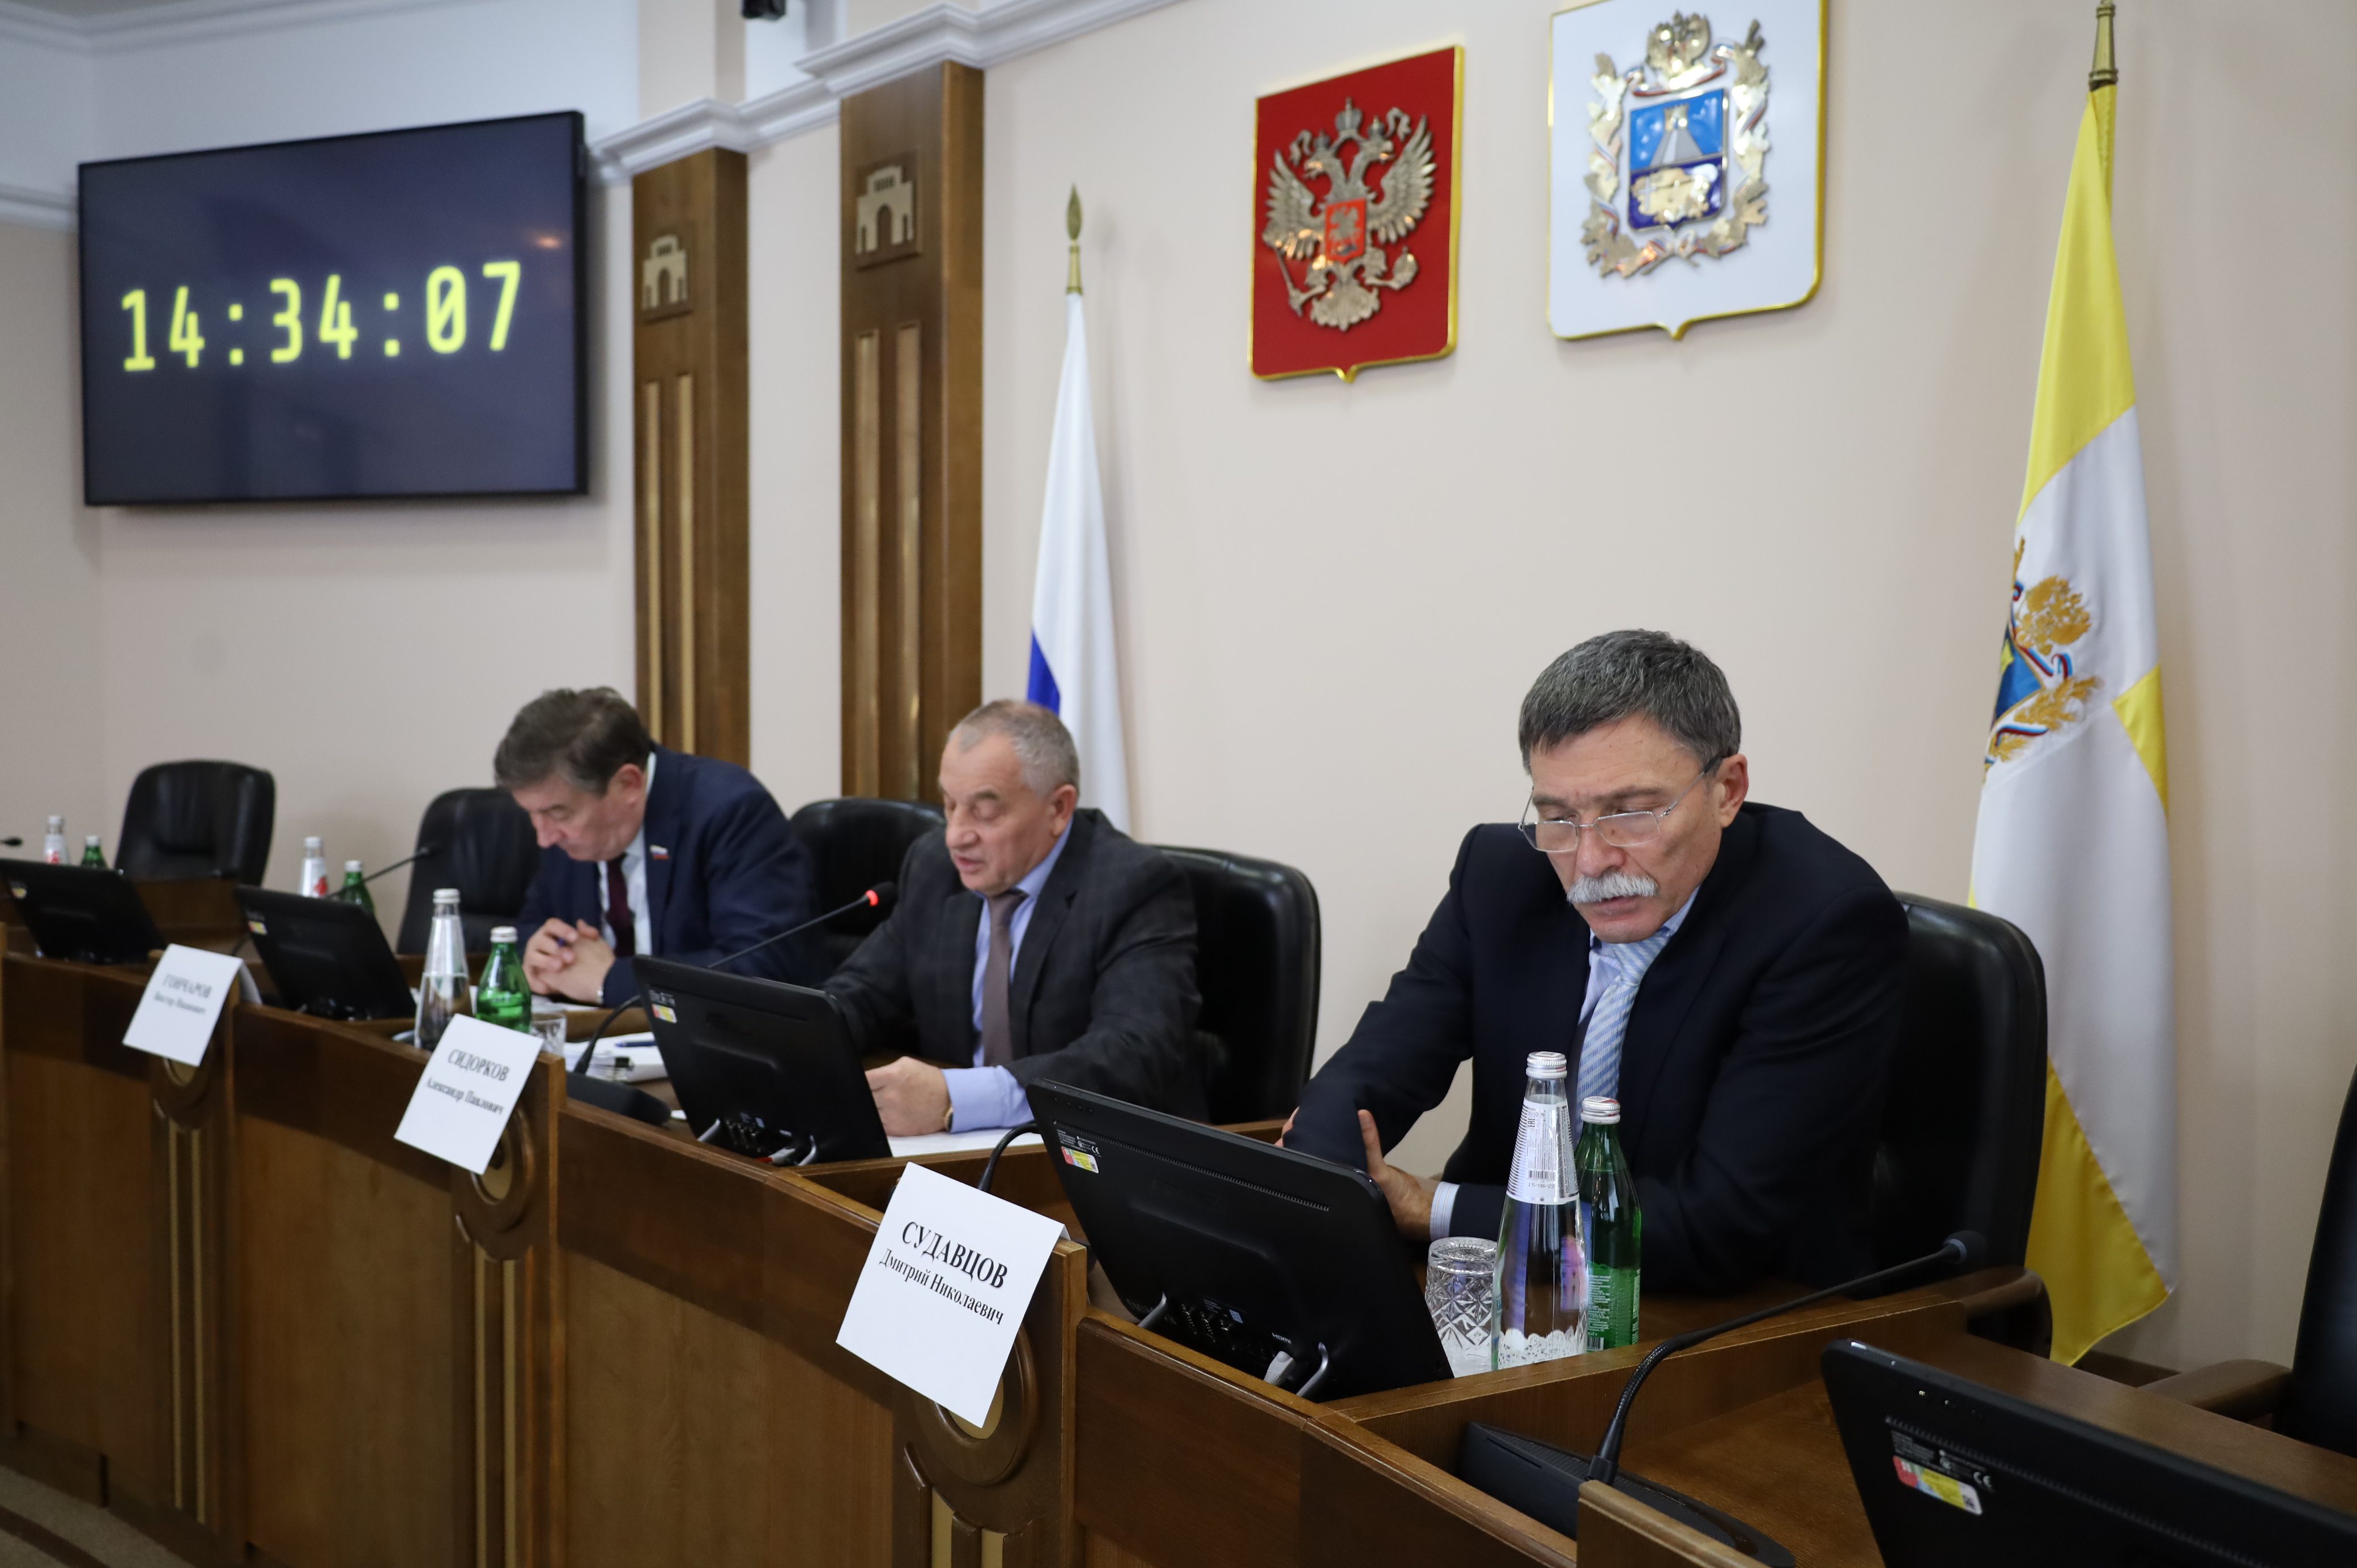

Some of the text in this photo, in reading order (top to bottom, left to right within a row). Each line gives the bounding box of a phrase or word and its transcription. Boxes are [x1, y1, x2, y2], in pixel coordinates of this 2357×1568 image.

[121, 260, 521, 372] 14:34:07
[426, 1077, 504, 1115] Александр Павлович
[447, 1049, 510, 1081] СИДОРКОВ
[879, 1248, 1004, 1326] Дмитрий Николаевич
[902, 1221, 1008, 1289] СУДАВЦОВ
